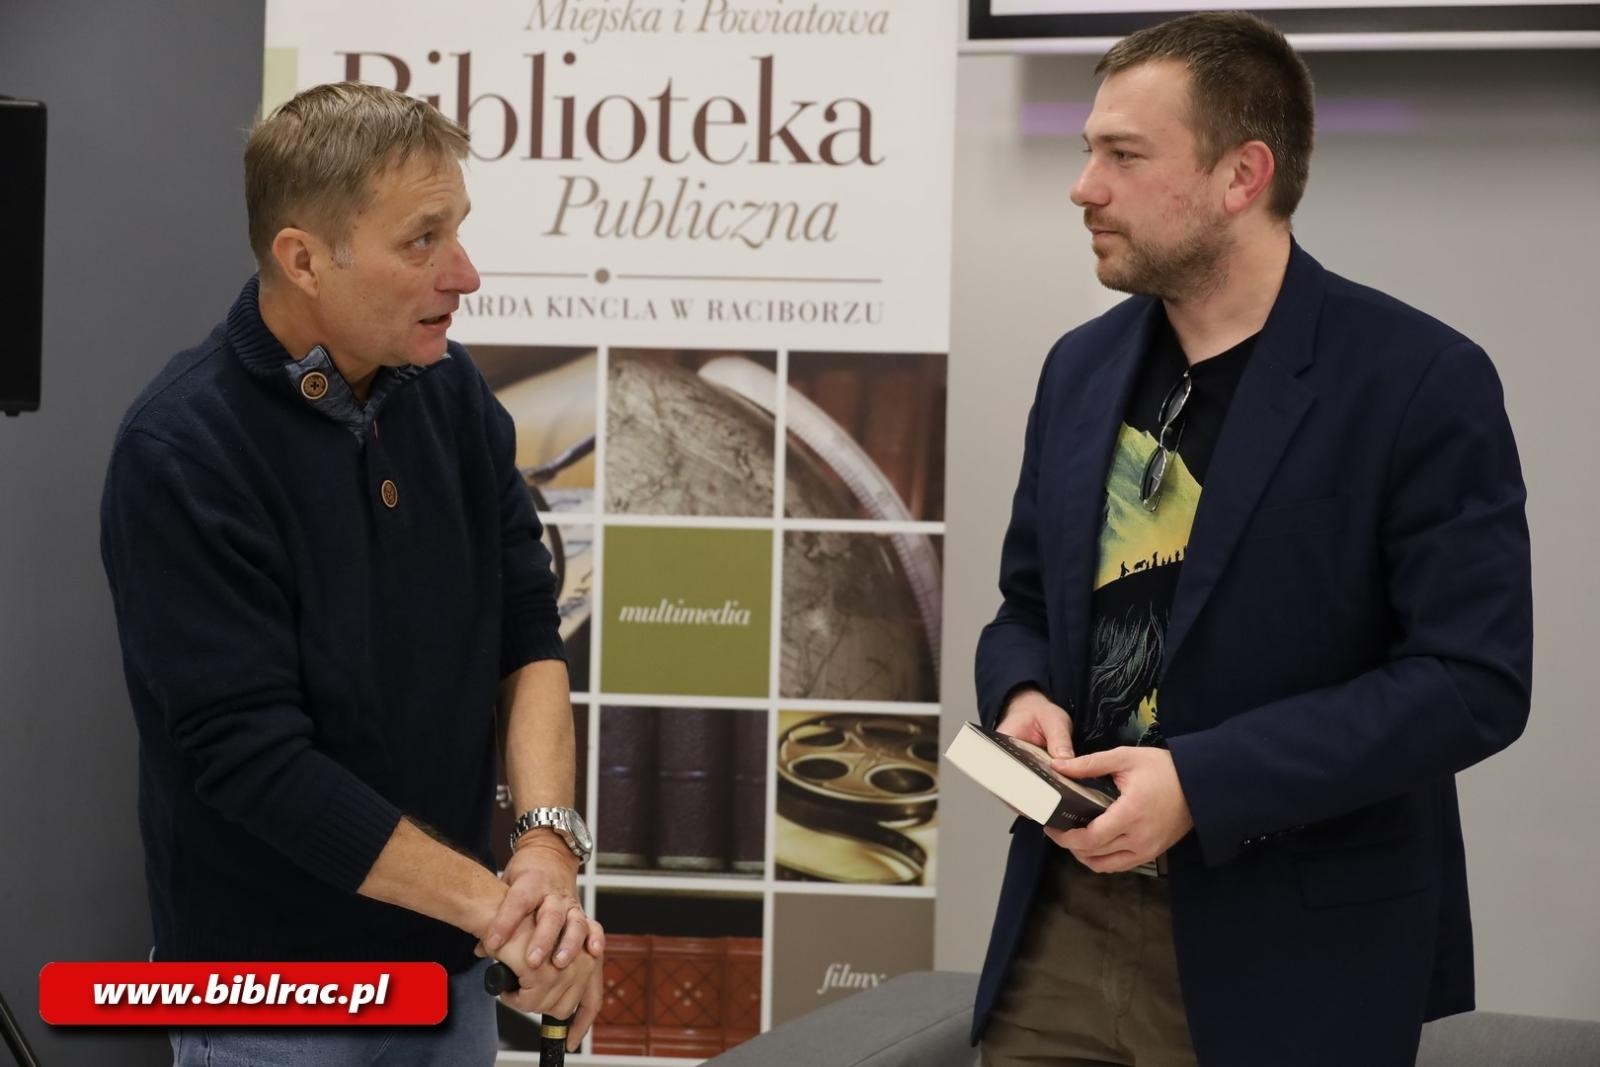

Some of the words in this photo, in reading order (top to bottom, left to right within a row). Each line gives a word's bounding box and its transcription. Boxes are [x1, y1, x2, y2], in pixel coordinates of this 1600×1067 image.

[523, 0, 662, 43] Miejska
[673, 0, 687, 33] i
[695, 0, 890, 35] Powiatowa
[541, 175, 839, 249] Publiczna
[546, 297, 659, 320] KINCLA
[670, 298, 695, 320] W
[706, 299, 885, 325] RACIBORZU
[618, 598, 751, 626] multimedia
